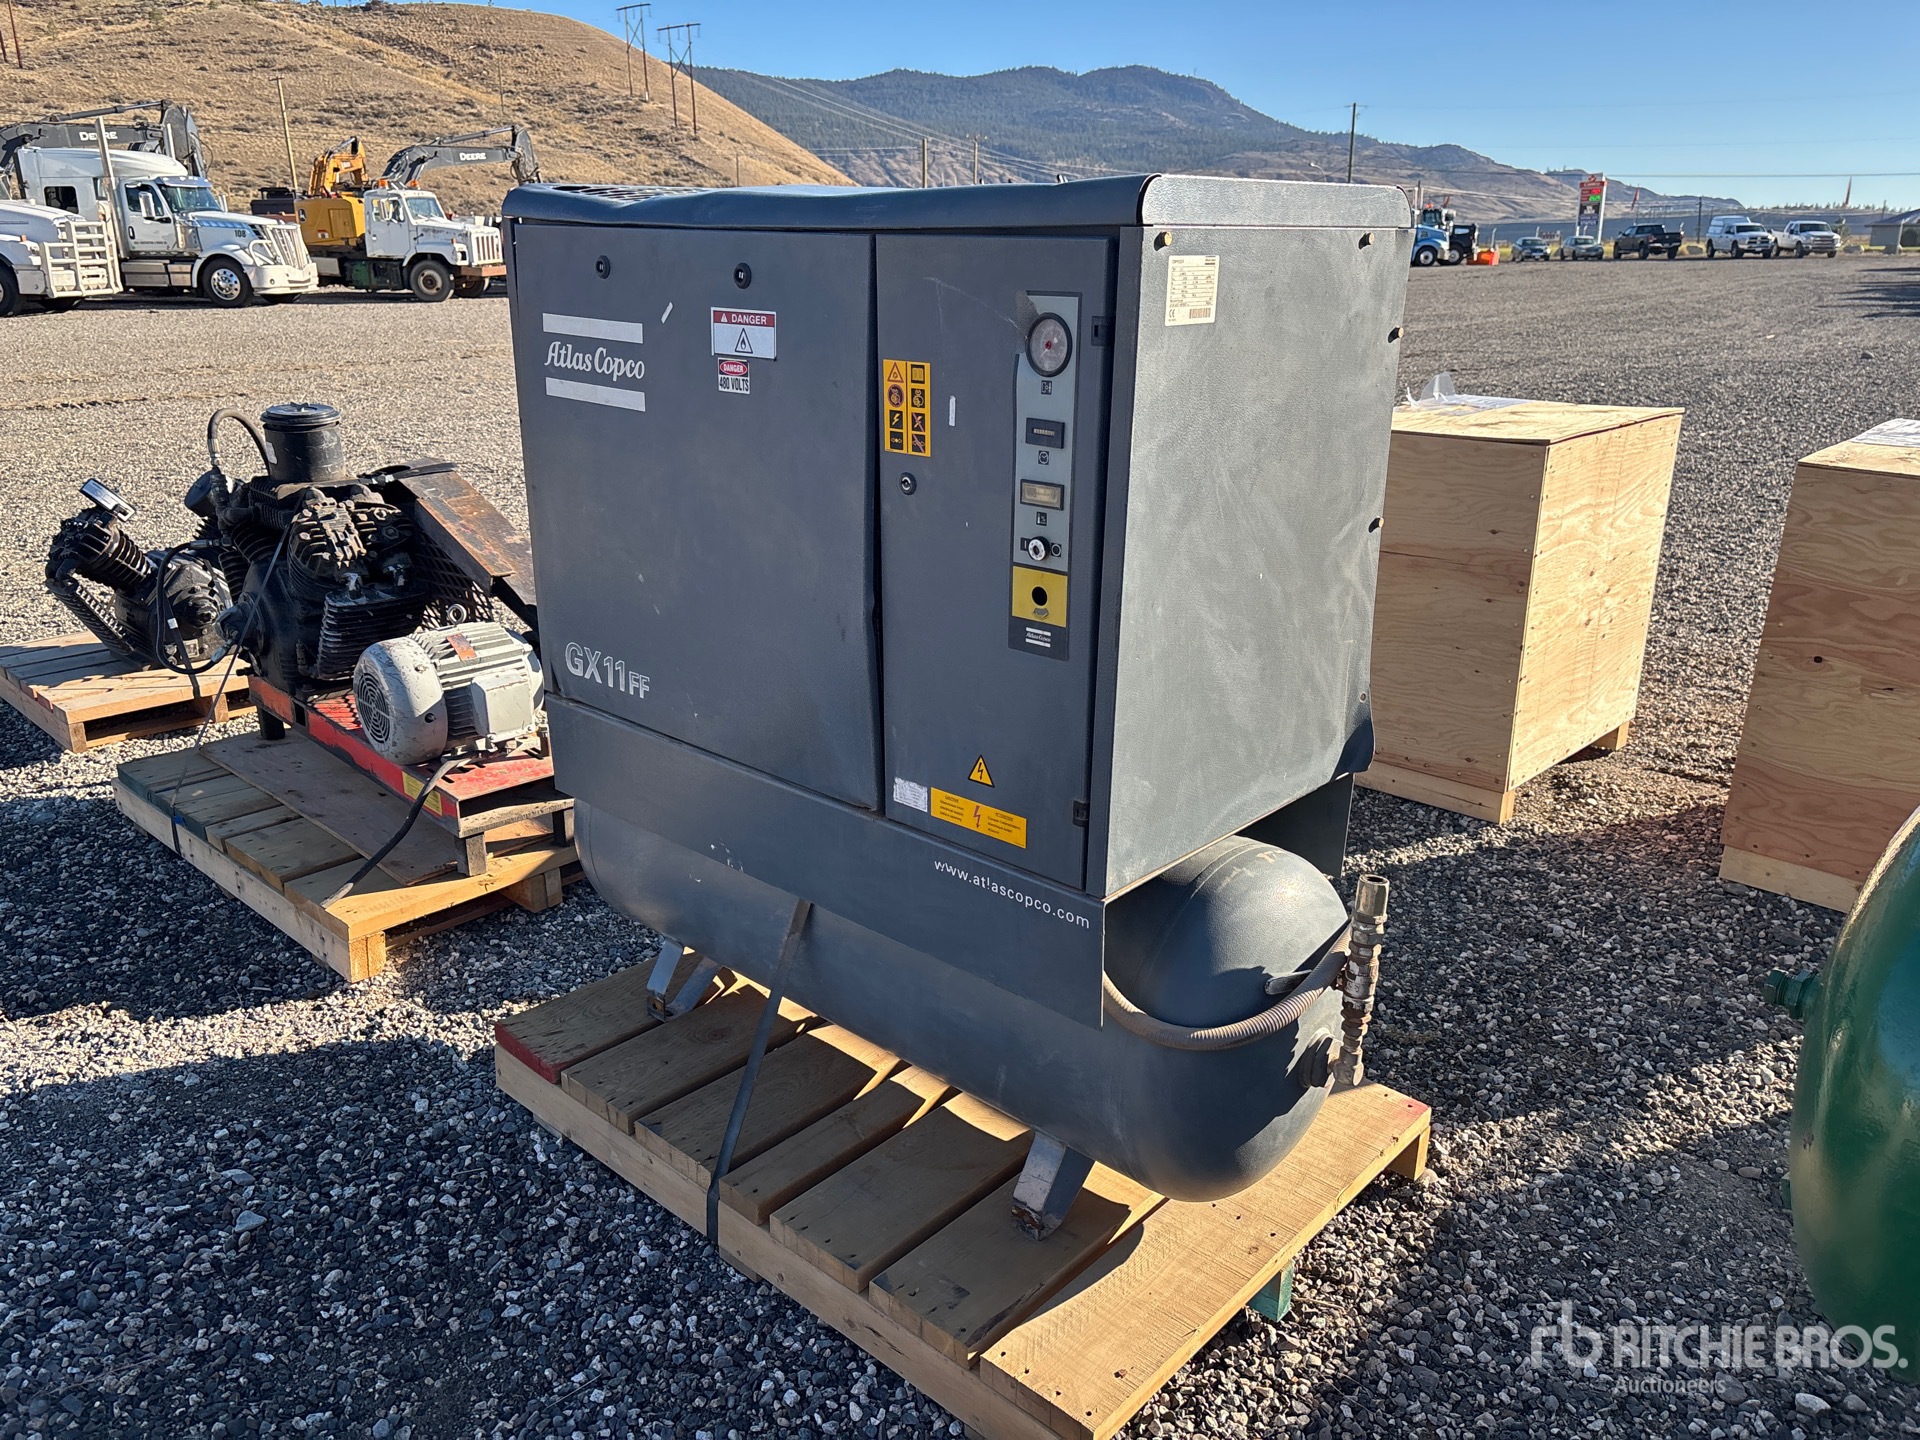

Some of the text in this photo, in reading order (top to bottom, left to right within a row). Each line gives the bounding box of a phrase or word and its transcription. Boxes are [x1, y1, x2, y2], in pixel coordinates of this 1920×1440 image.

[79, 131, 118, 141] DERE
[459, 152, 487, 161] DEERE
[731, 313, 767, 325] DANGER
[544, 341, 645, 382] Atlas Copco
[723, 363, 744, 373] DANGER
[719, 376, 749, 392] 480 VOLTS
